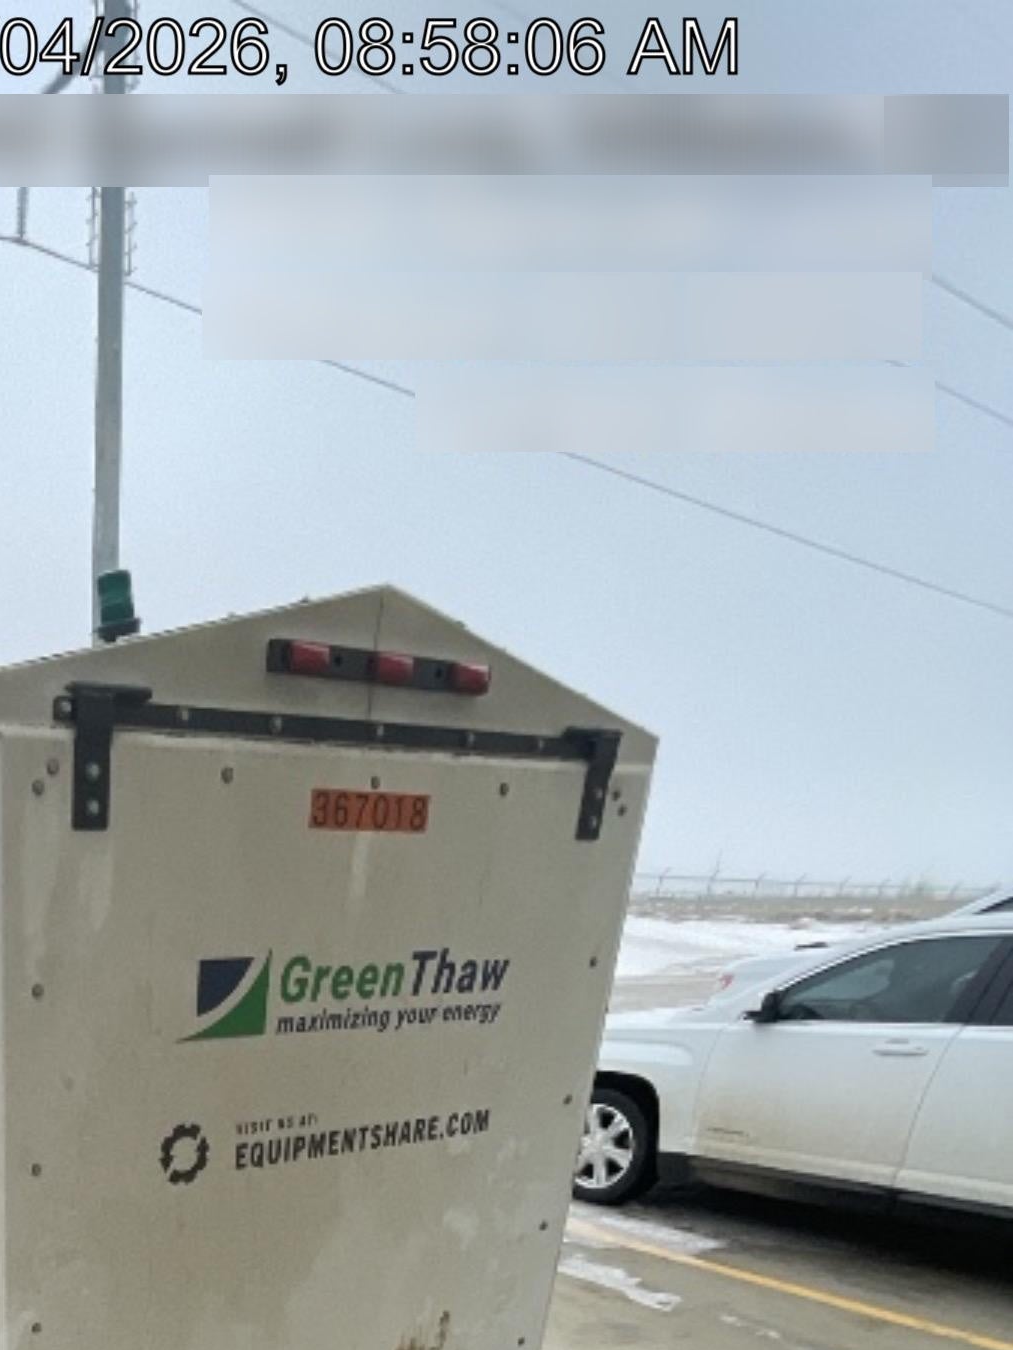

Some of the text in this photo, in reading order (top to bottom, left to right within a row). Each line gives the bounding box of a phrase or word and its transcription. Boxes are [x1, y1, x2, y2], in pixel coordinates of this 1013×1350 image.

[313, 790, 426, 832] 367018
[276, 1001, 502, 1035] maximizing your energy
[235, 1108, 491, 1170] EQUIPMENTSHARE.COM
